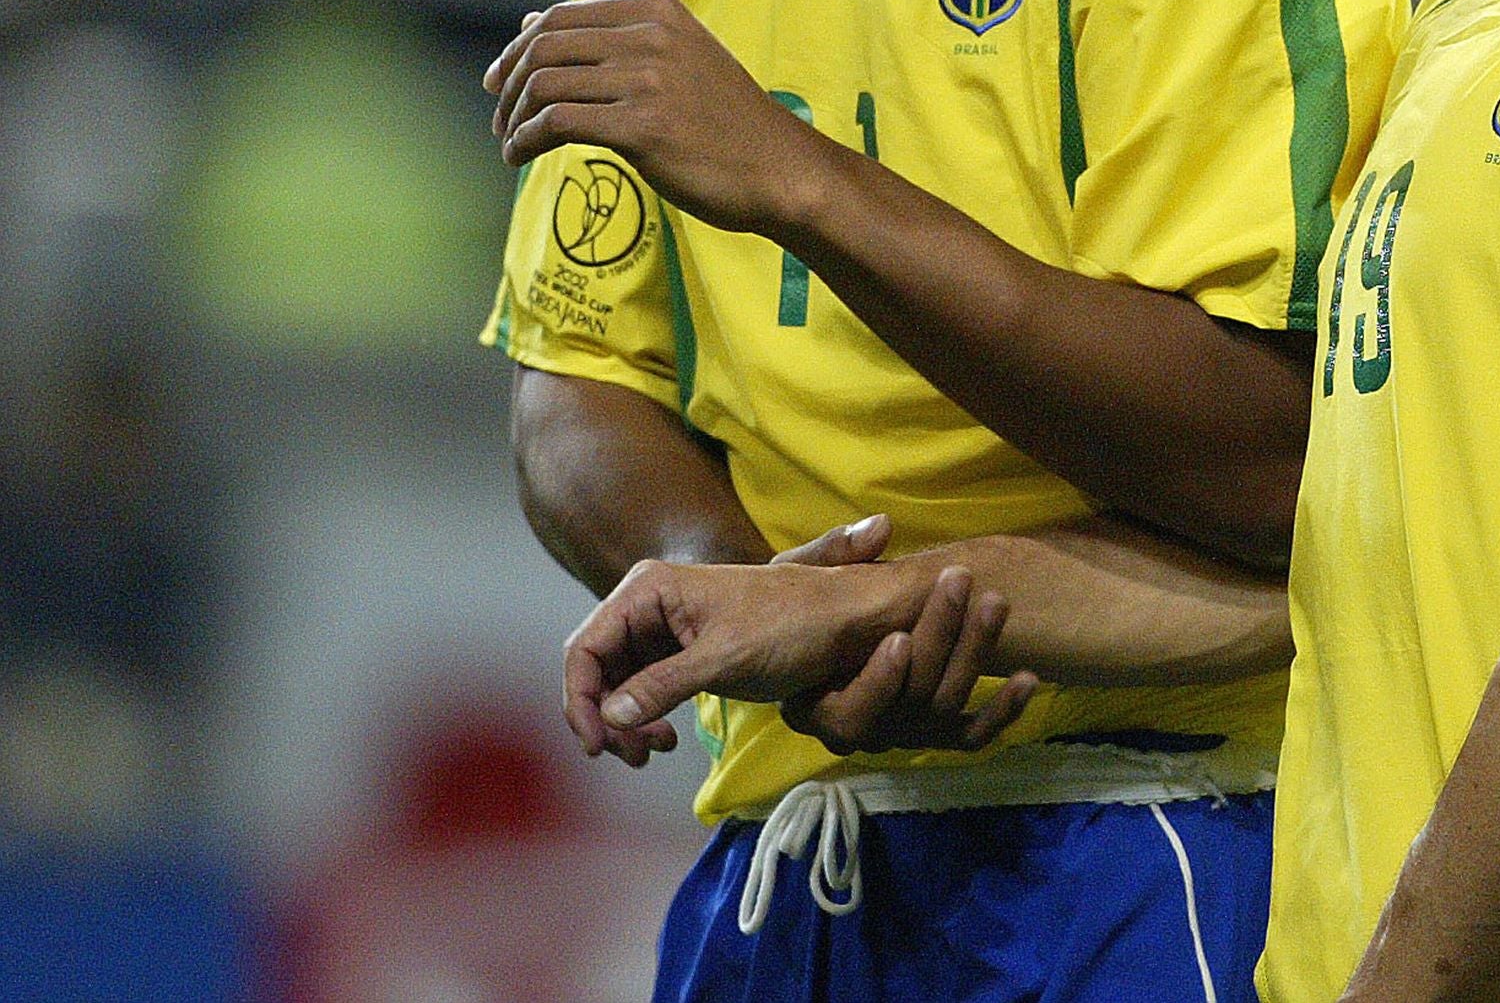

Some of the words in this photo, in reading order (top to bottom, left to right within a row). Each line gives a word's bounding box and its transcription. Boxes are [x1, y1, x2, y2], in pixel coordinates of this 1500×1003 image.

[953, 43, 998, 56] BRASIL
[554, 262, 589, 291] 2002
[1323, 159, 1415, 399] 19
[588, 298, 614, 316] CUP
